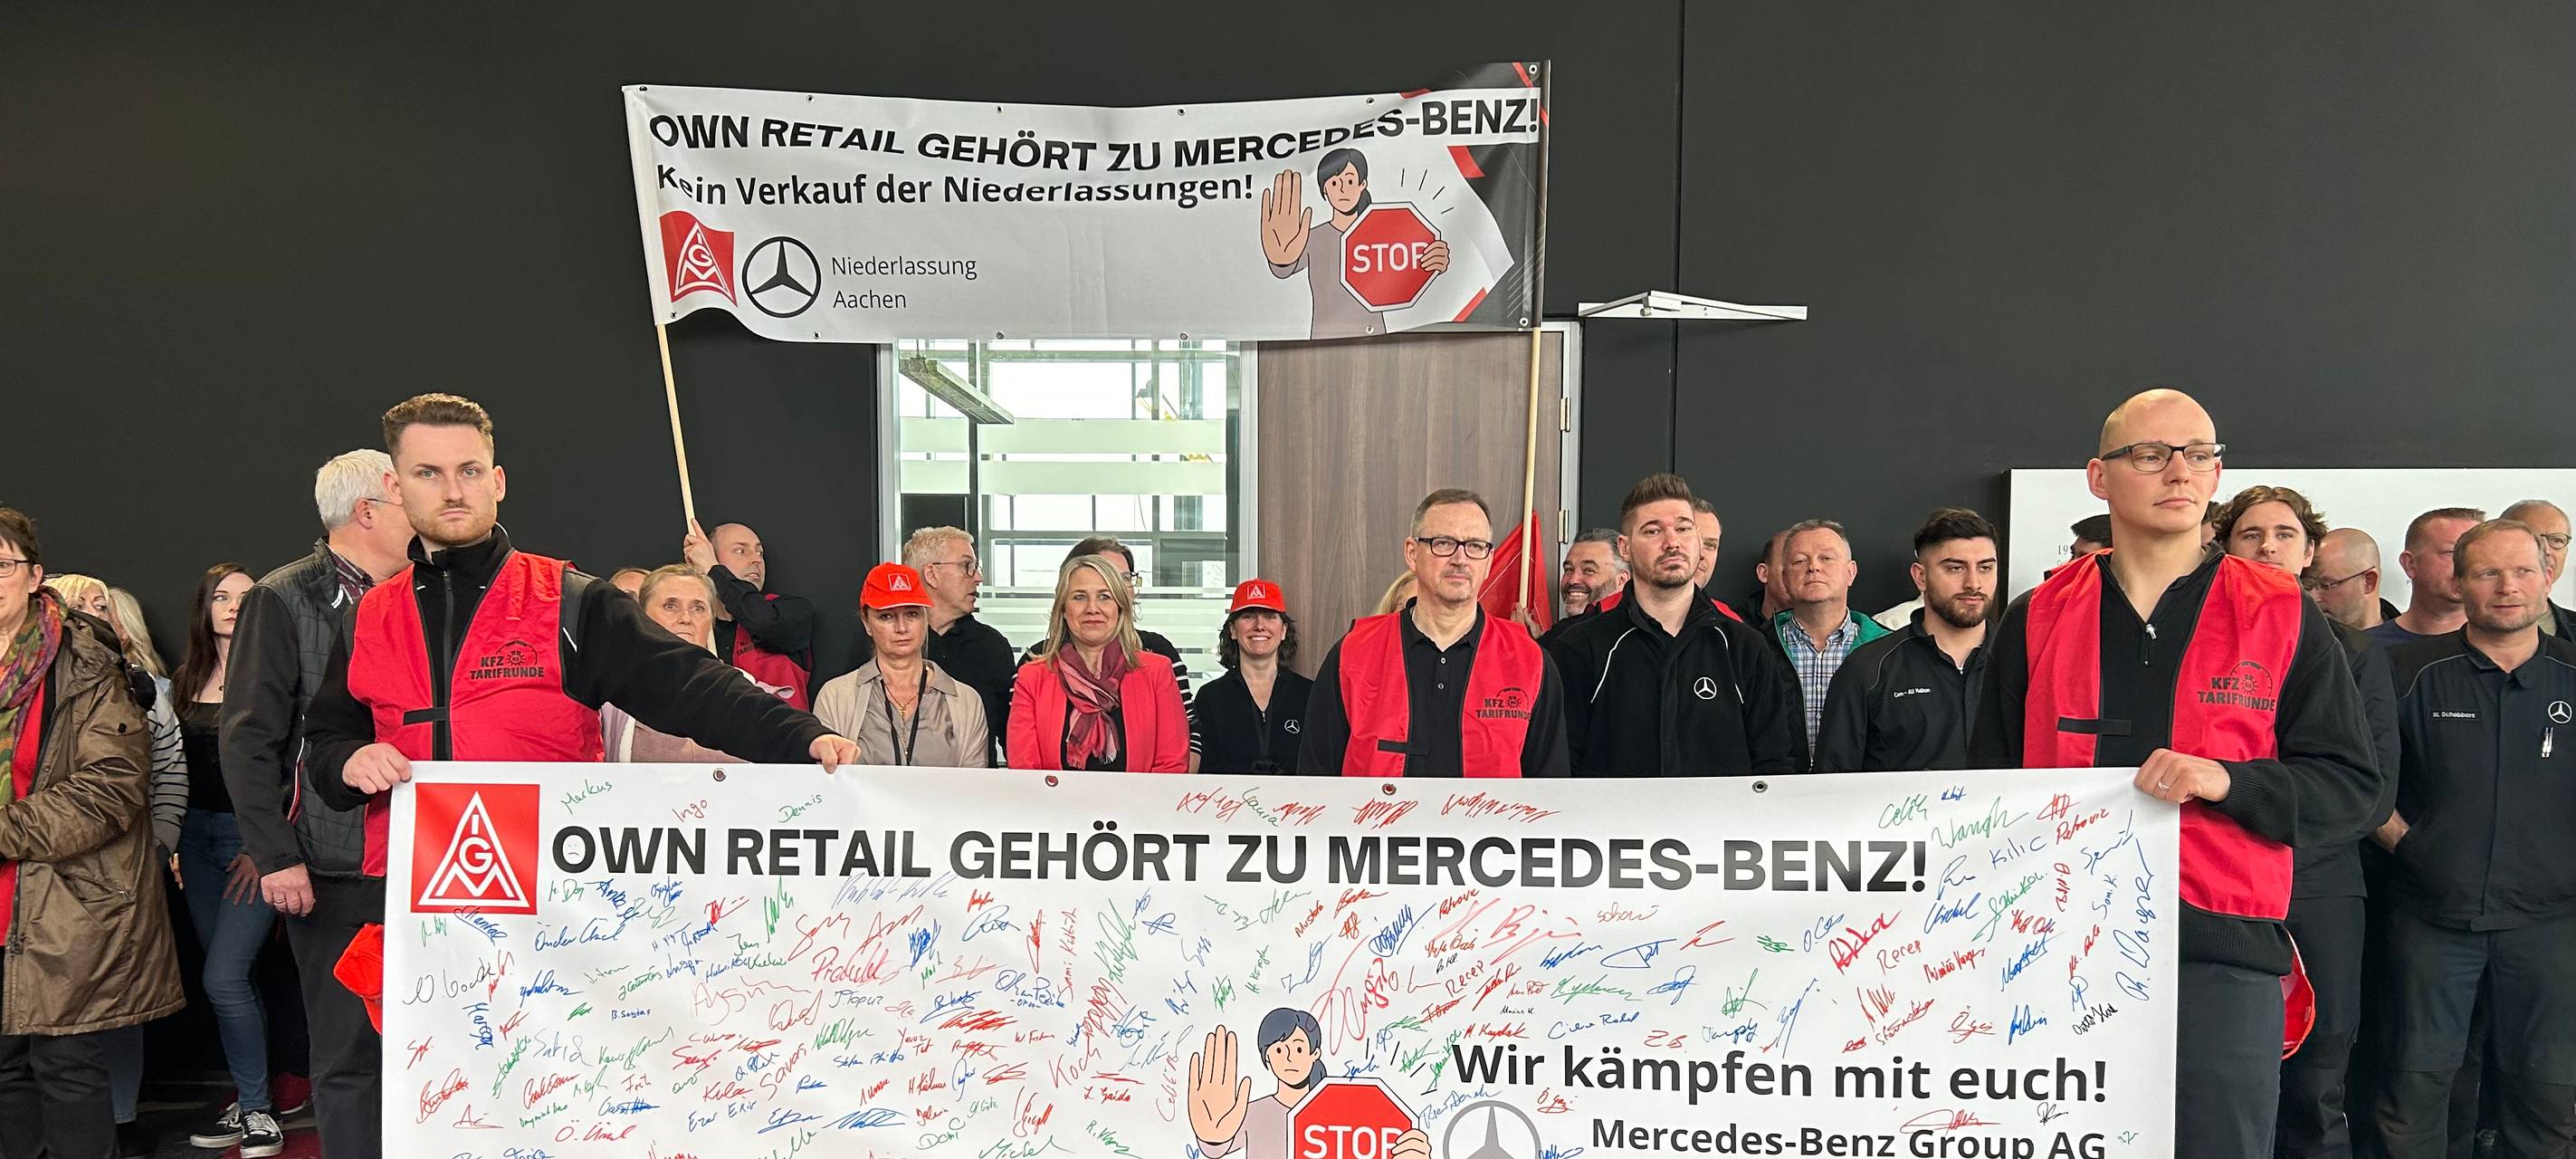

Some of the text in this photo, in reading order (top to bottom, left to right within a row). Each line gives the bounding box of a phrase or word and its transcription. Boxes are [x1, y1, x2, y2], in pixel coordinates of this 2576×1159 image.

[649, 97, 1539, 172] OWN RETAIL GEHÖRT ZU MERCEDES-BENZ!
[657, 164, 1253, 209] Kein Verkauf der Niederlassungen!
[831, 256, 978, 280] Niederlassung
[1351, 242, 1429, 273] STOP
[832, 291, 907, 310] Aachen
[470, 666, 545, 680] TARIFRUNDE
[481, 656, 504, 667] KFZ
[2211, 677, 2240, 690] KFZ
[1484, 698, 1504, 708] KFZ
[2198, 691, 2275, 712] TARIFRUNDE
[560, 779, 614, 815] Markus
[778, 793, 823, 823] Dennis
[552, 820, 1926, 893] OWN RETAIL GEHÖRT ZU MERCEDES-BENZ!
[1452, 1043, 2106, 1105] Wir kämpfen mit euch!
[1592, 1118, 2106, 1159] Mercedes-Benz Group AG
